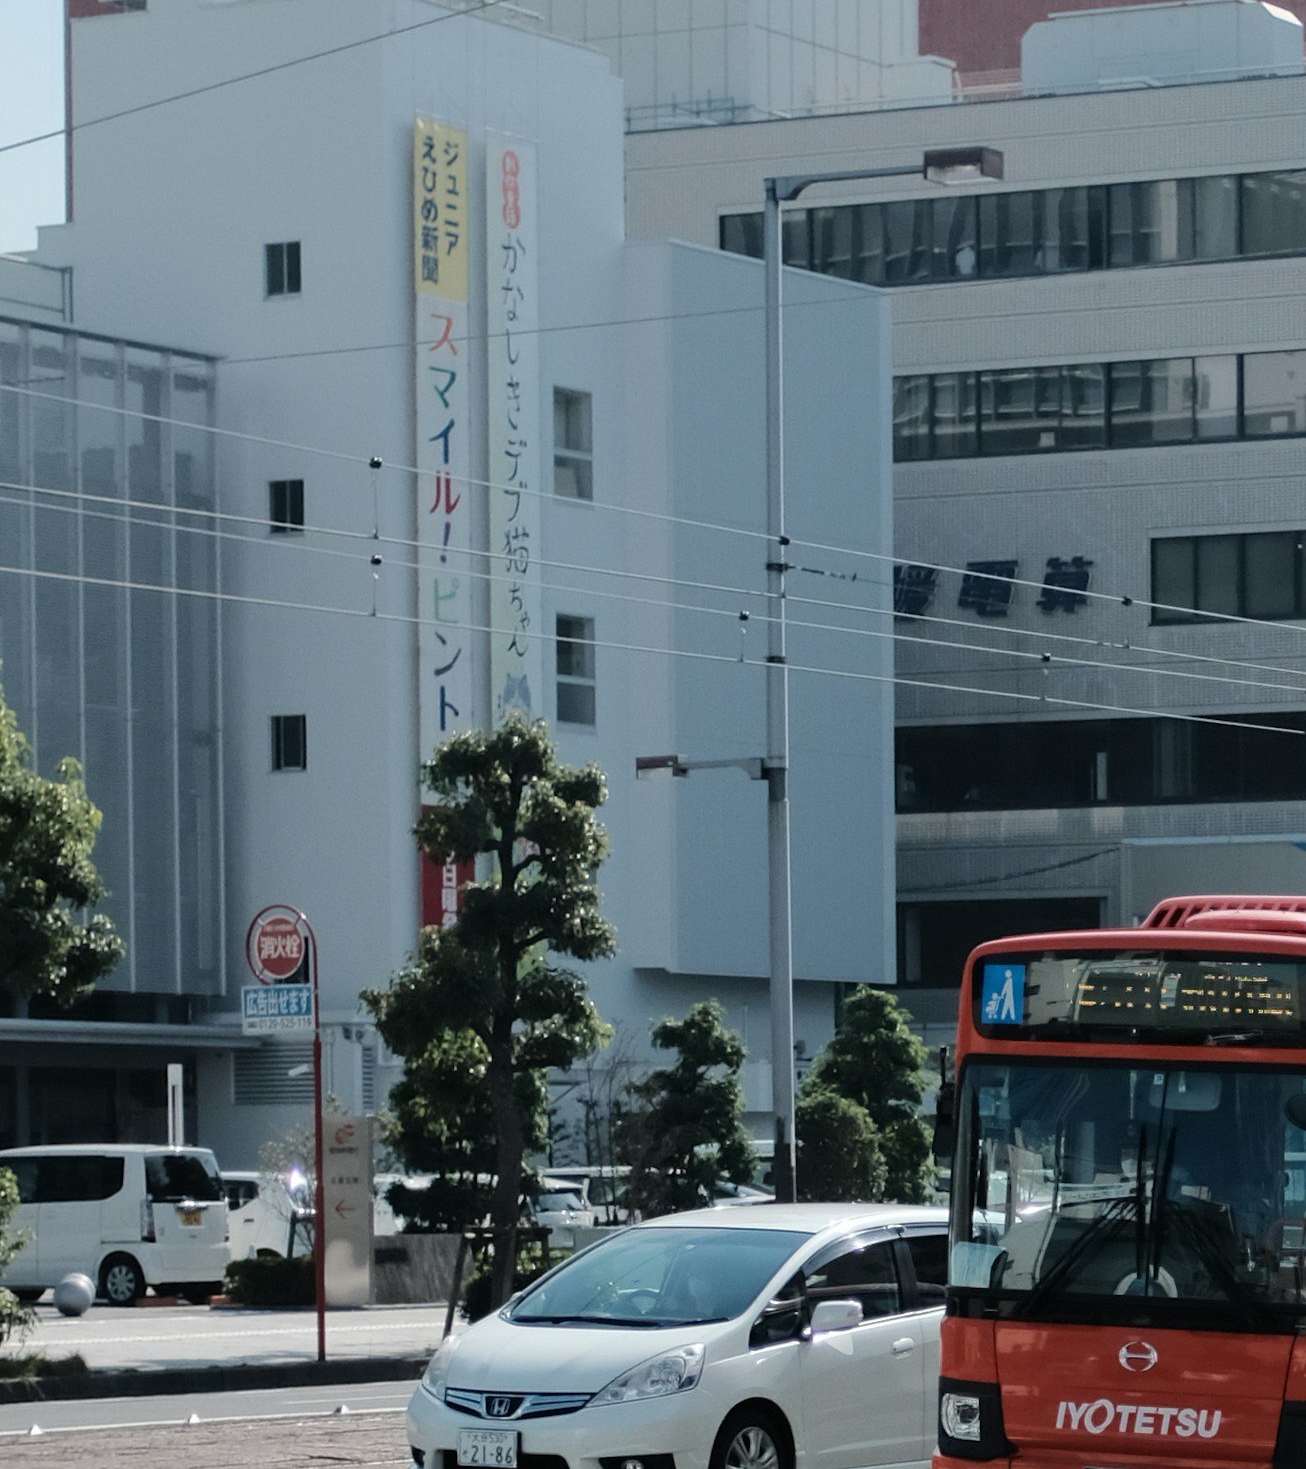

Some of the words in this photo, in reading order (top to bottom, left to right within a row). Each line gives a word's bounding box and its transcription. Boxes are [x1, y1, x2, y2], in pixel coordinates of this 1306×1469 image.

[421, 135, 438, 286] えひめ新聞
[443, 140, 460, 256] ジュニア
[260, 934, 300, 960] 消火栓
[246, 990, 310, 1016] 広告出せます
[1056, 1399, 1222, 1438] IYOTETSU
[471, 1445, 513, 1464] 21-86
